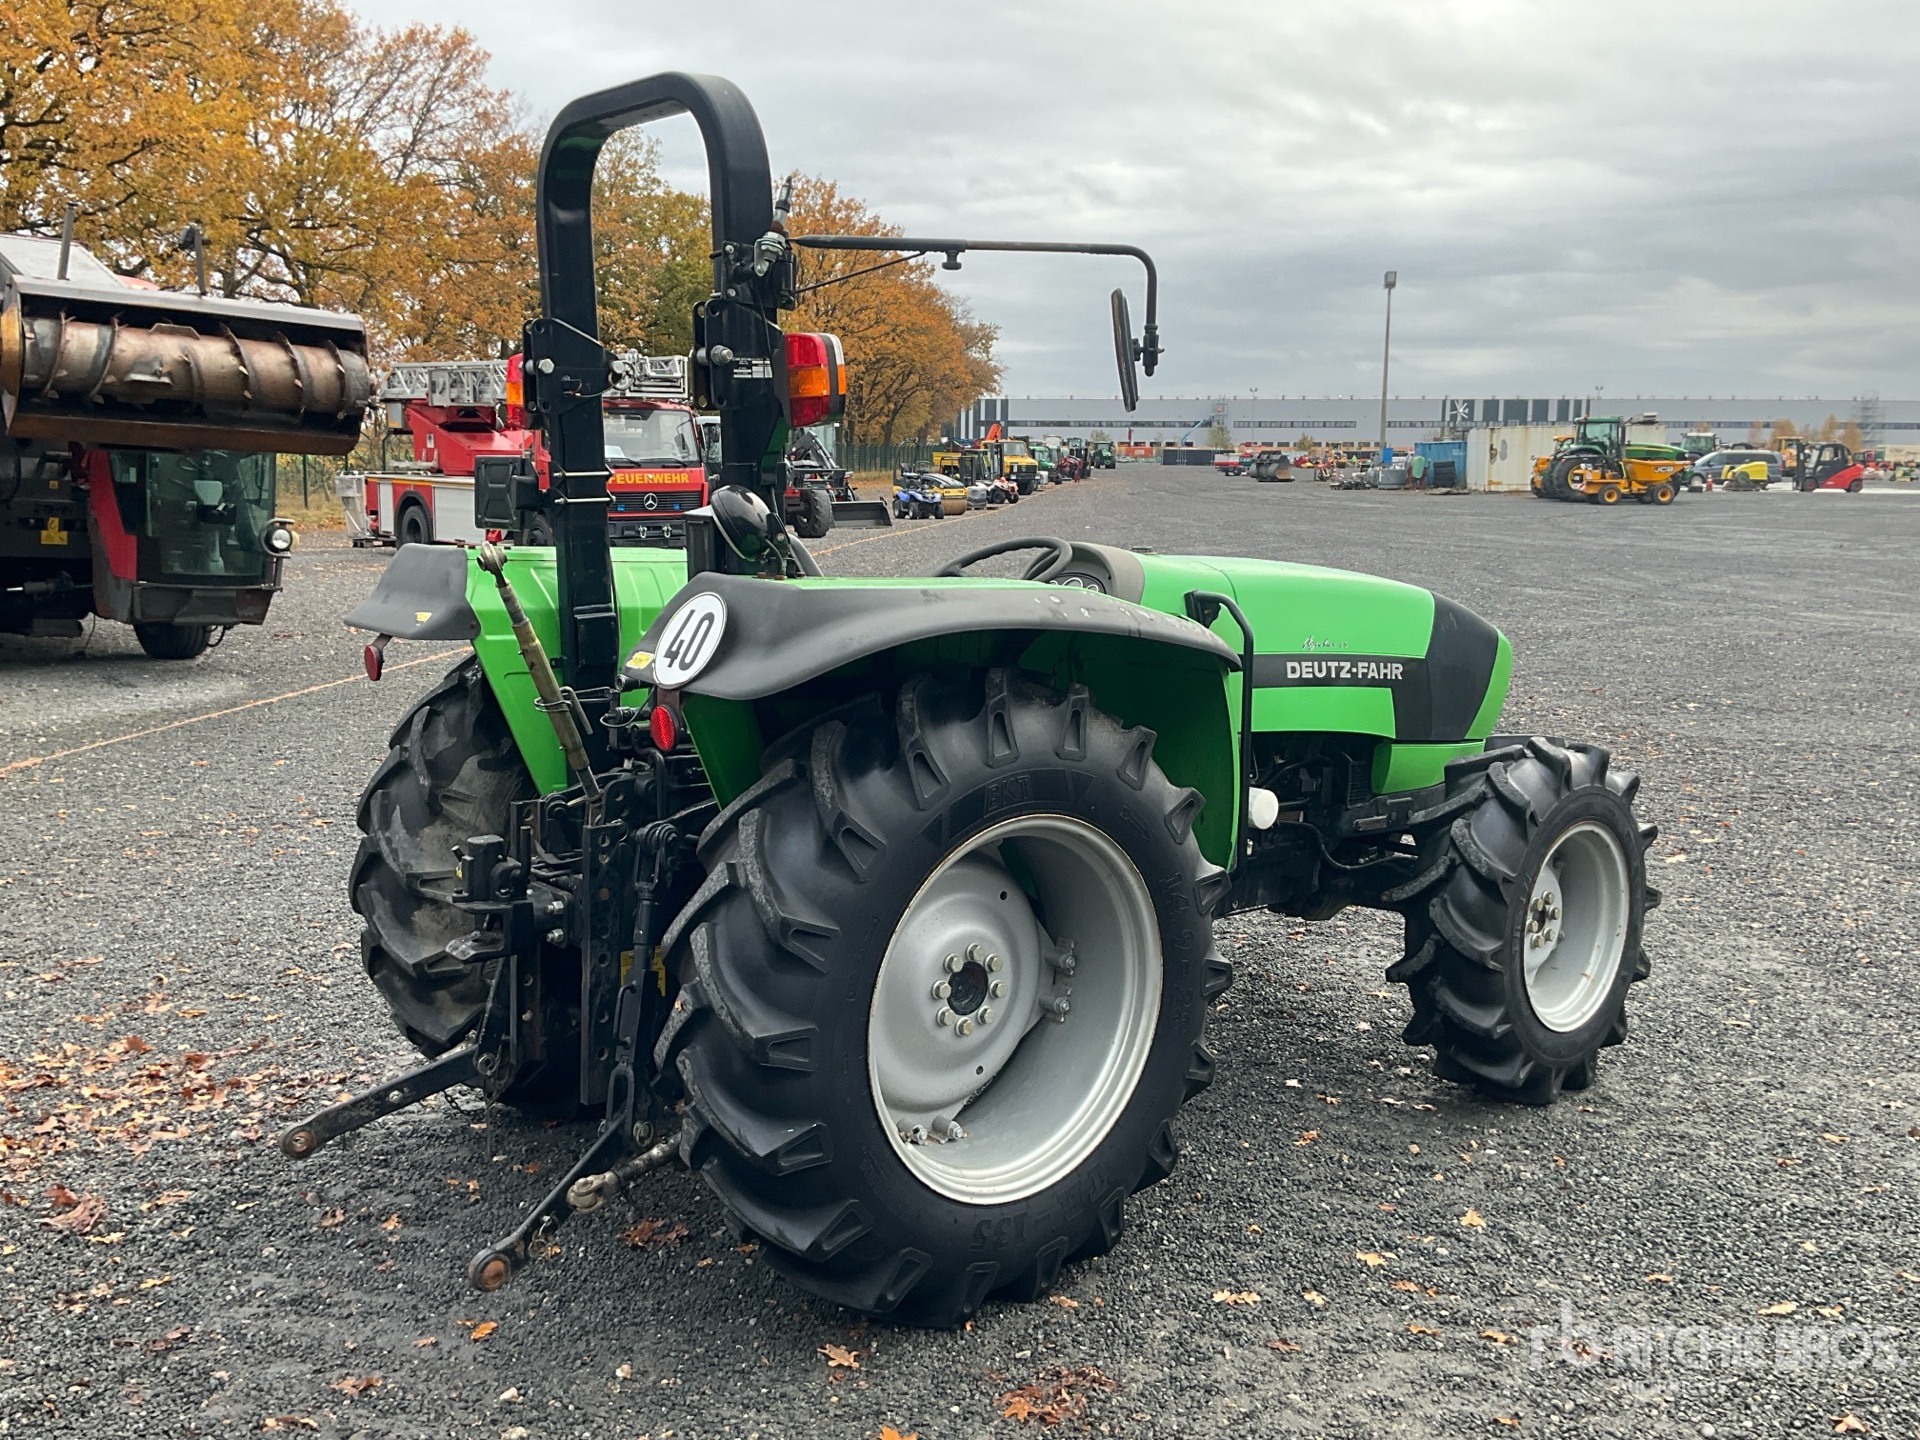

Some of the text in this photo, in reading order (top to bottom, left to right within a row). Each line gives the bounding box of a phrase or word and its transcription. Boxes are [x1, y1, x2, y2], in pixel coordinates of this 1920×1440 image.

[662, 609, 716, 672] 40
[1285, 660, 1404, 680] DEUTZ-FAHR
[986, 774, 1031, 811] BKT
